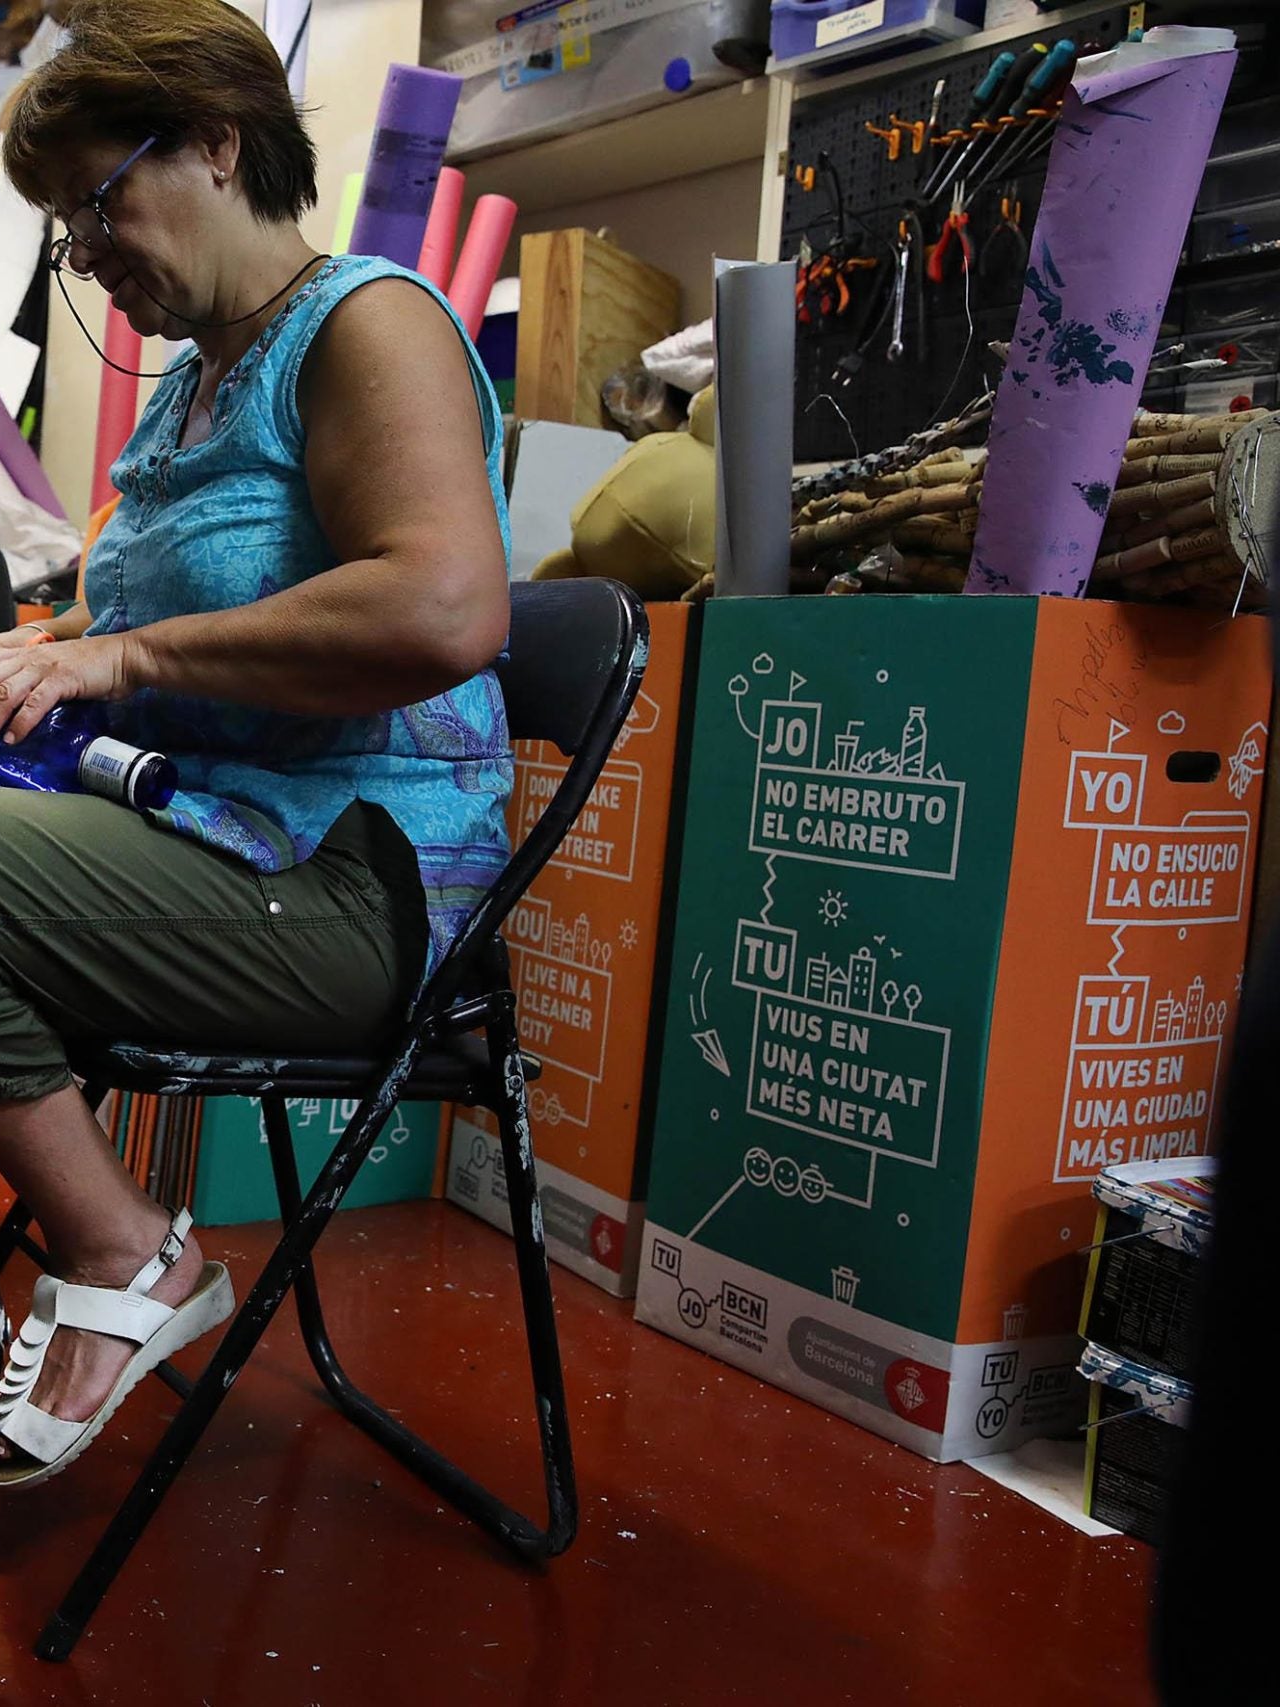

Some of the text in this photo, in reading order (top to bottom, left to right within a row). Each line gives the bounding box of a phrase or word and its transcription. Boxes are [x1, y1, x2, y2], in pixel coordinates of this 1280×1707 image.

[766, 717, 807, 757] JO
[587, 786, 621, 810] AKE
[765, 778, 947, 825] NO EMBRUTO
[1080, 770, 1132, 814] YO
[582, 811, 600, 834] IN
[761, 811, 910, 858] EL CARRER
[1110, 842, 1239, 875] NO ENSUCIO
[1106, 875, 1213, 908] LA CALLE
[743, 935, 788, 981] TU
[525, 959, 592, 1001] LIVE IN A
[522, 991, 592, 1032] CLEANER
[766, 1003, 869, 1055] VIUS EN
[1085, 985, 1135, 1037] TÚ
[520, 1018, 553, 1046] CITY
[762, 1043, 927, 1108] UNA CIUTAT
[1079, 1056, 1184, 1090] VIVES EN
[758, 1076, 894, 1141] MÉS NETA
[1073, 1090, 1208, 1129] UNA CIUDAD
[1068, 1128, 1198, 1168] MÁS LIMPIA
[657, 1246, 676, 1269] TU
[682, 1298, 702, 1319] JO
[726, 1290, 762, 1321] BCN
[719, 1325, 763, 1354] Barcelona
[720, 1315, 768, 1344] Compartim
[804, 1344, 875, 1387] Barcelona
[862, 1357, 877, 1368] de
[989, 1355, 1012, 1381] TÚ
[982, 1408, 1004, 1430] YO
